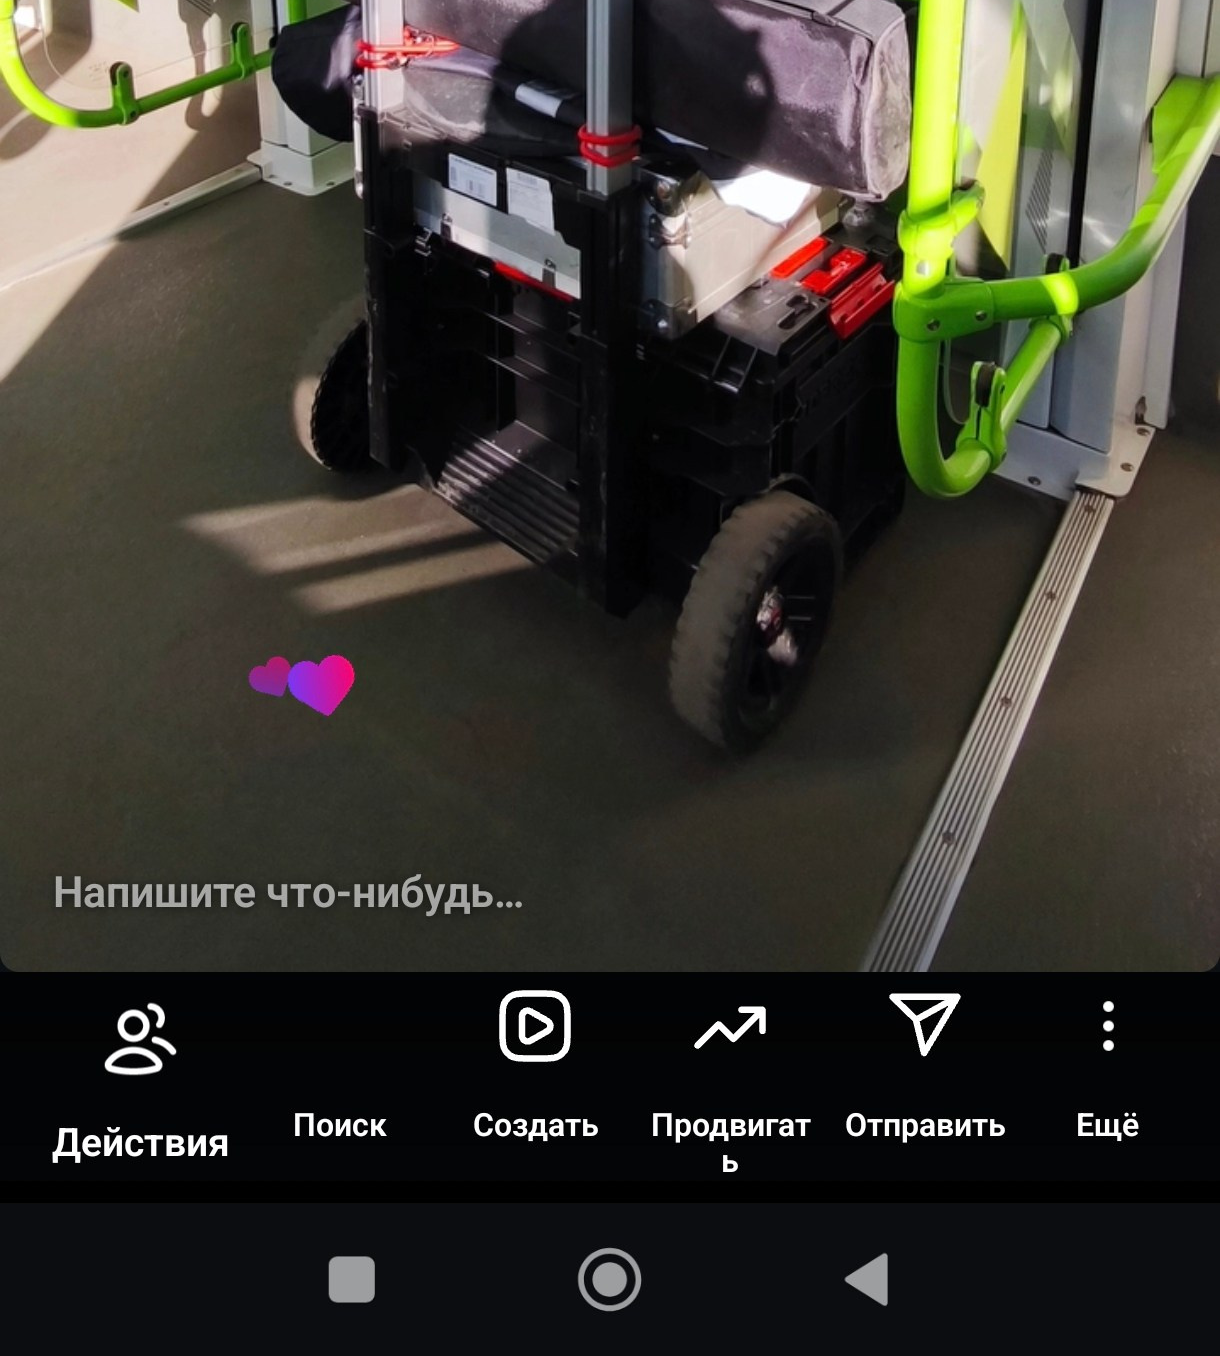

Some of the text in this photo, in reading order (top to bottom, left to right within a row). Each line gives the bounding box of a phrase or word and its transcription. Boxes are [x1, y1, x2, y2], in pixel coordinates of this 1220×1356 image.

[294, 1112, 388, 1138] Поиск
[473, 1112, 599, 1142] Создать
[652, 1112, 812, 1144] Продвигат
[845, 1112, 1006, 1144] Отправить
[1077, 1112, 1140, 1142] Ещё
[51, 1126, 229, 1164] Действия
